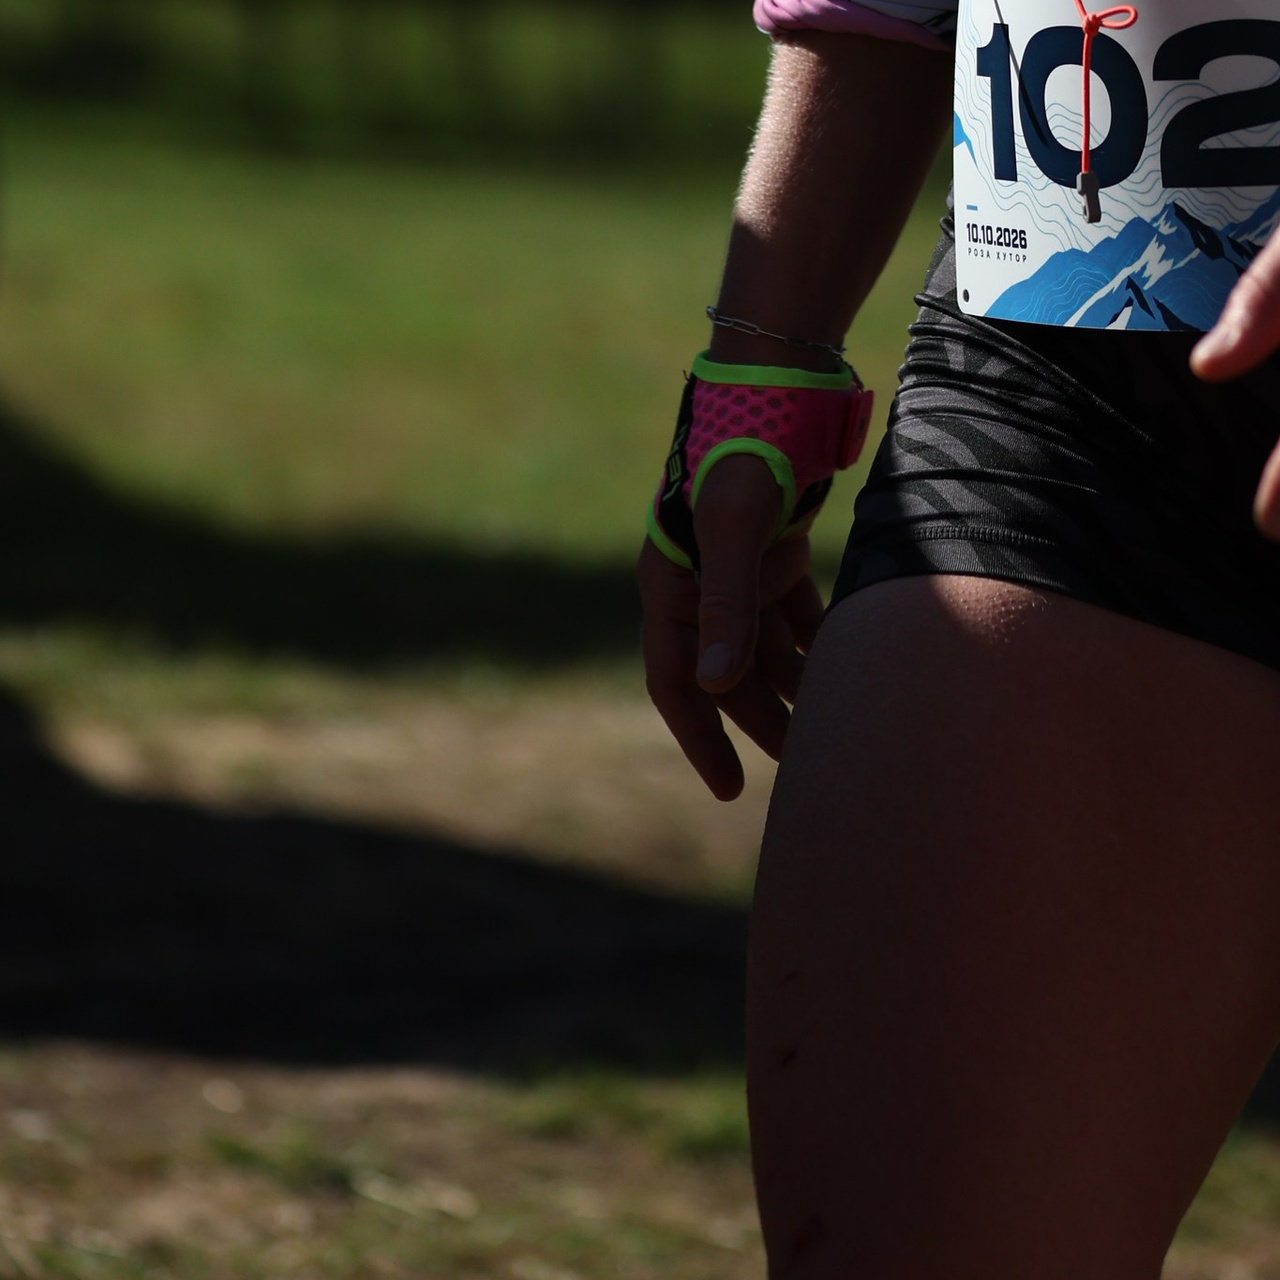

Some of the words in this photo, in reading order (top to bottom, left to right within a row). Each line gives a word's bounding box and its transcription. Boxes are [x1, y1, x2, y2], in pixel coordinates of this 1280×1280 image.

[966, 222, 1028, 250] 10.10.2026
[967, 247, 991, 259] РОЗА
[995, 251, 1027, 263] ХУТОР
